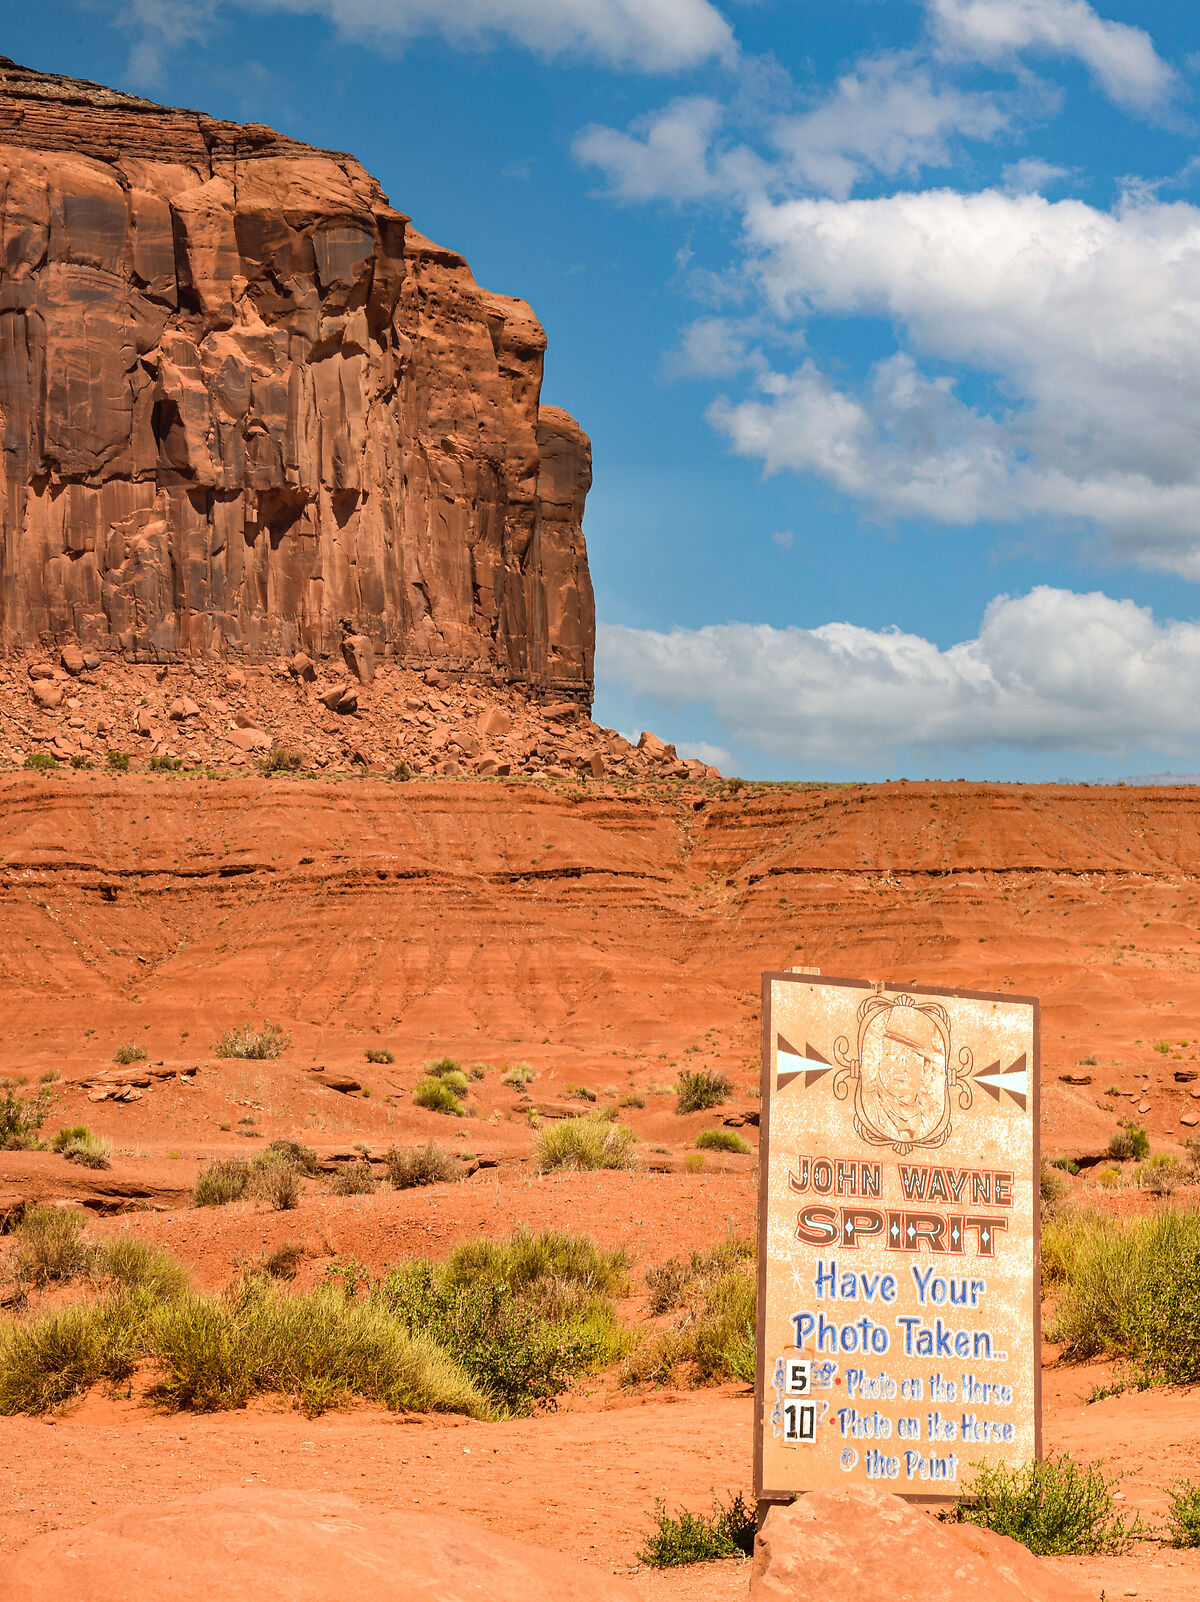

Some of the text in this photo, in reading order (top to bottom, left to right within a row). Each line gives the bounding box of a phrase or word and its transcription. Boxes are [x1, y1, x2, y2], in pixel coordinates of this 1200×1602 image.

[789, 1155, 1014, 1208] JOHN WAYNE
[795, 1204, 1008, 1257] SPIRIT
[813, 1258, 986, 1307] Have Your
[791, 1312, 889, 1352] Photo
[845, 1368, 897, 1399] Photo
[901, 1377, 924, 1400] on
[928, 1373, 958, 1403] the
[961, 1373, 1013, 1405] Horse
[837, 1407, 892, 1440] Photo
[898, 1417, 921, 1440] on
[926, 1412, 957, 1442] the
[961, 1413, 1015, 1443] Horse
[865, 1449, 900, 1479] the
[904, 1450, 959, 1481] Point
